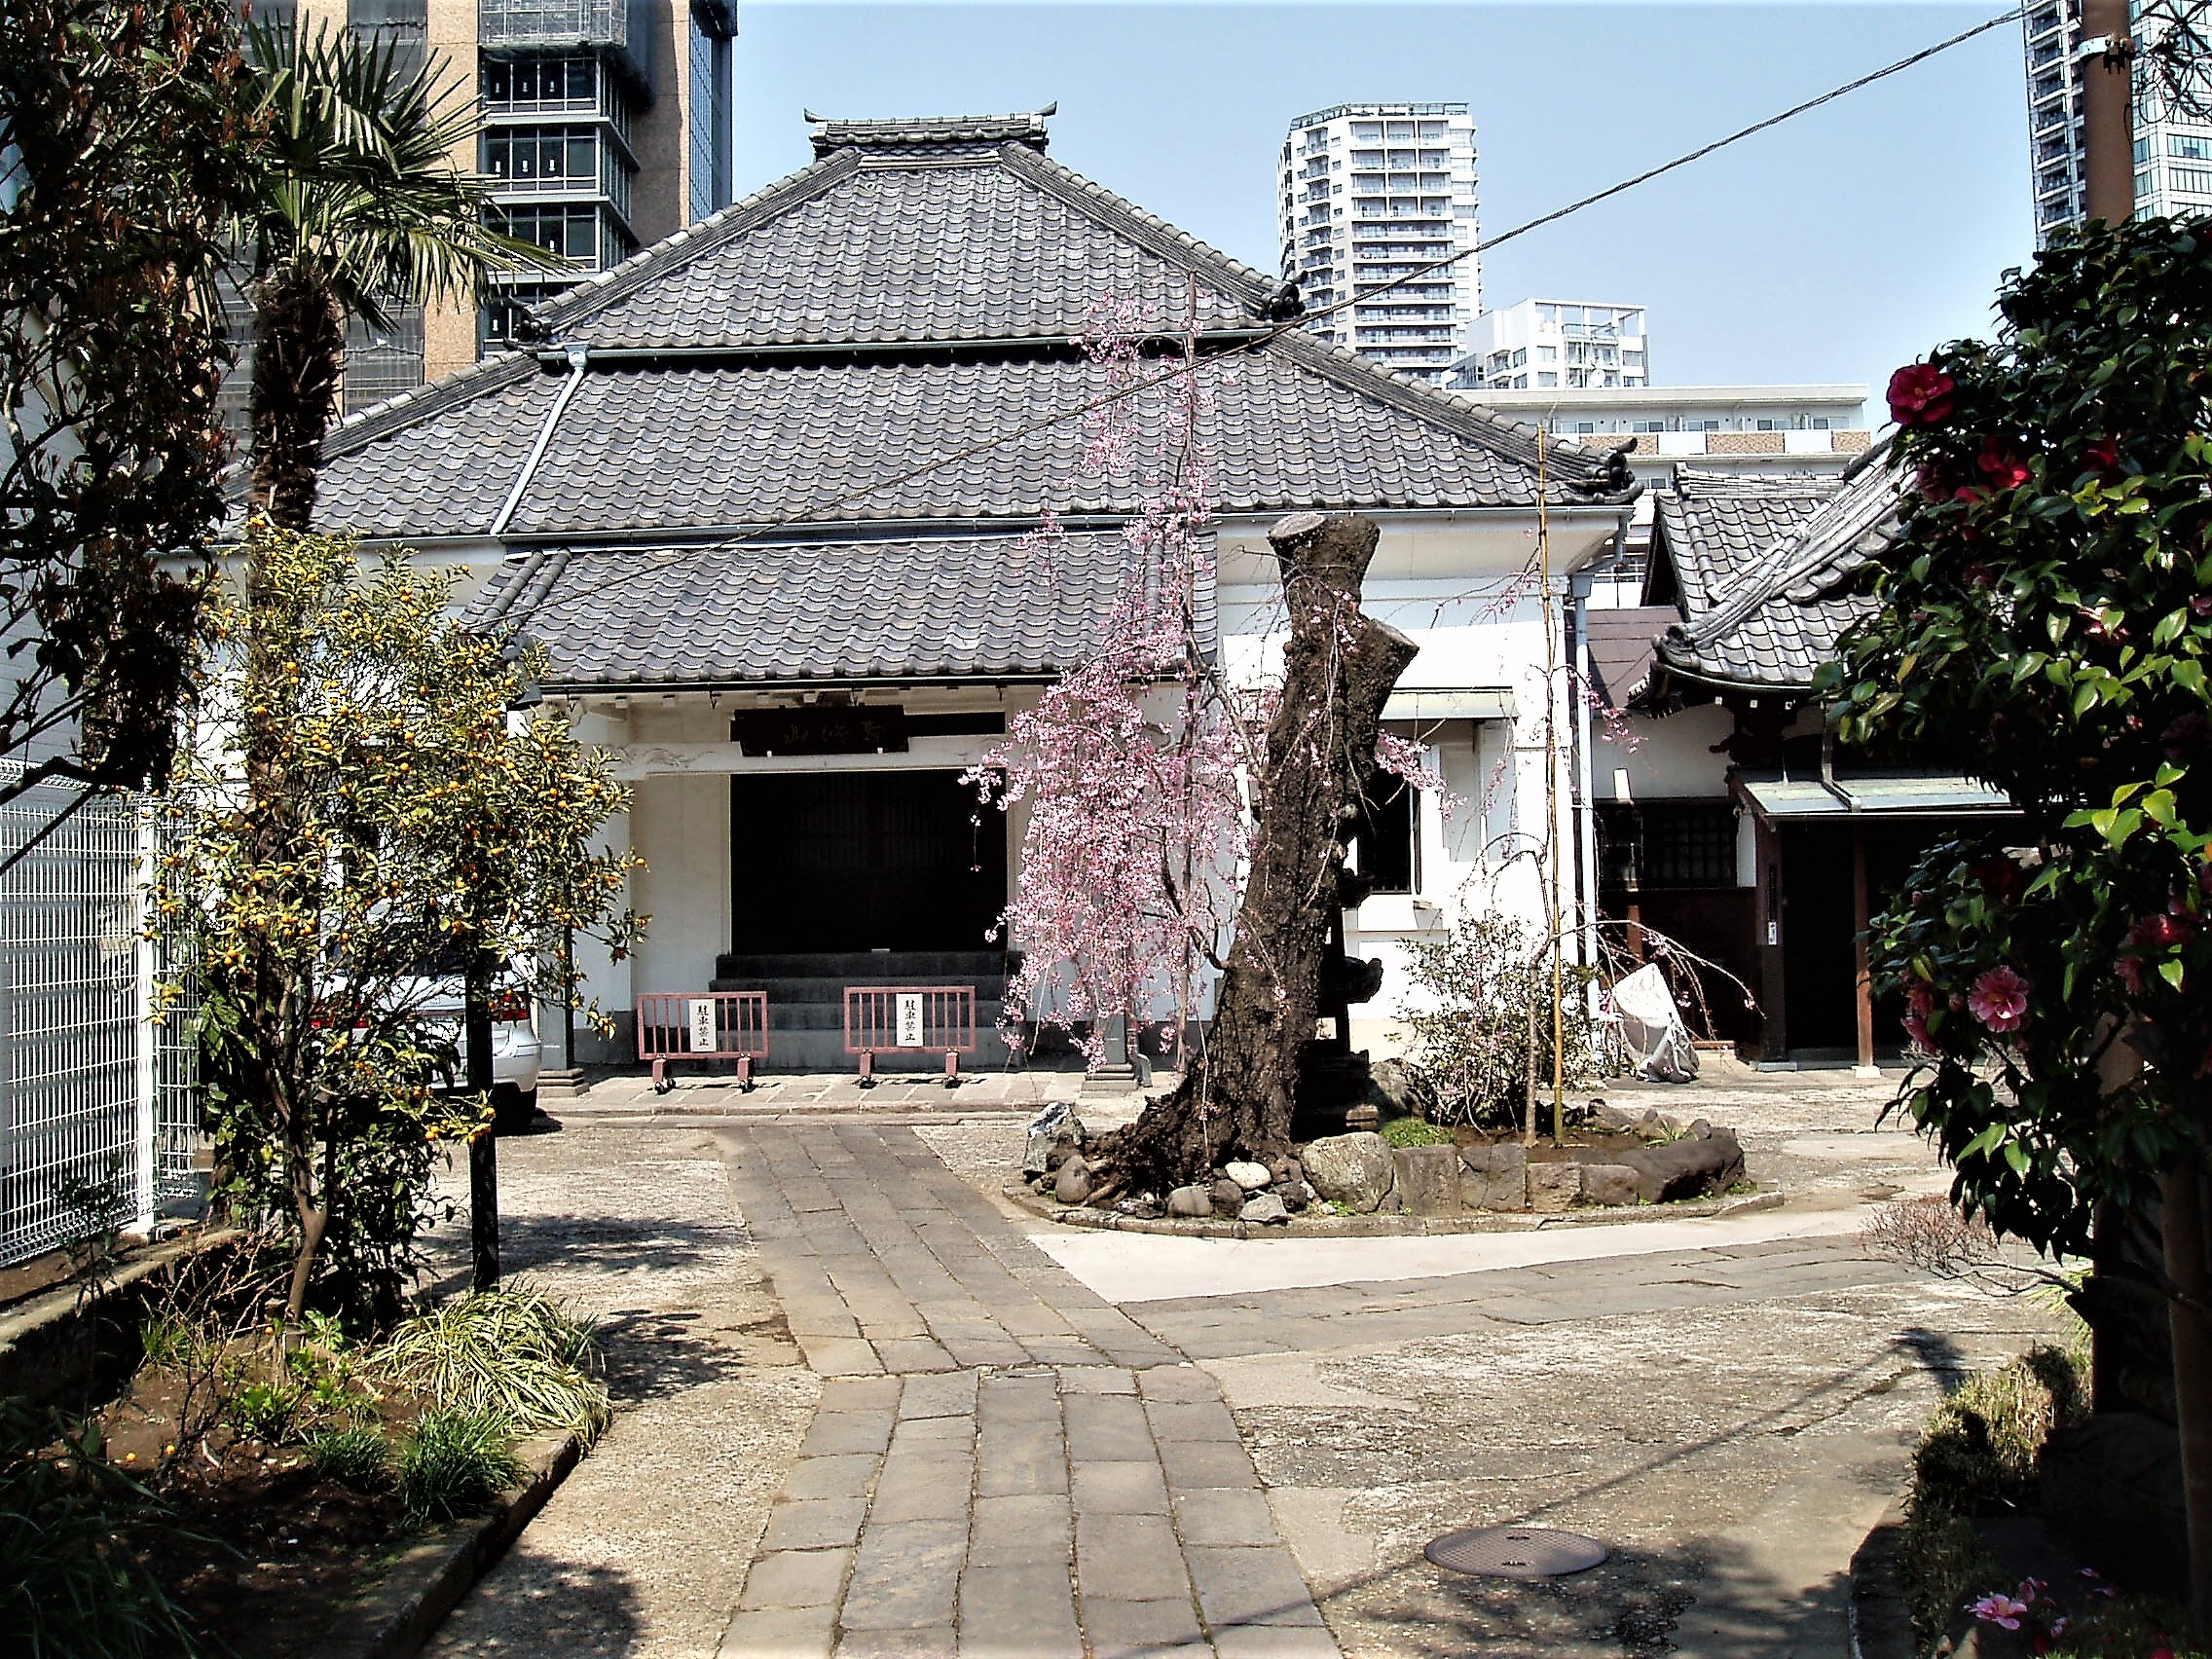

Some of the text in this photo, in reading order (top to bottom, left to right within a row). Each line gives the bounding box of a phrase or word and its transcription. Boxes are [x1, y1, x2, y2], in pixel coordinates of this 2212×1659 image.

[696, 1004, 710, 1047] 駐車禁止
[903, 999, 917, 1042] 駐車禁止
